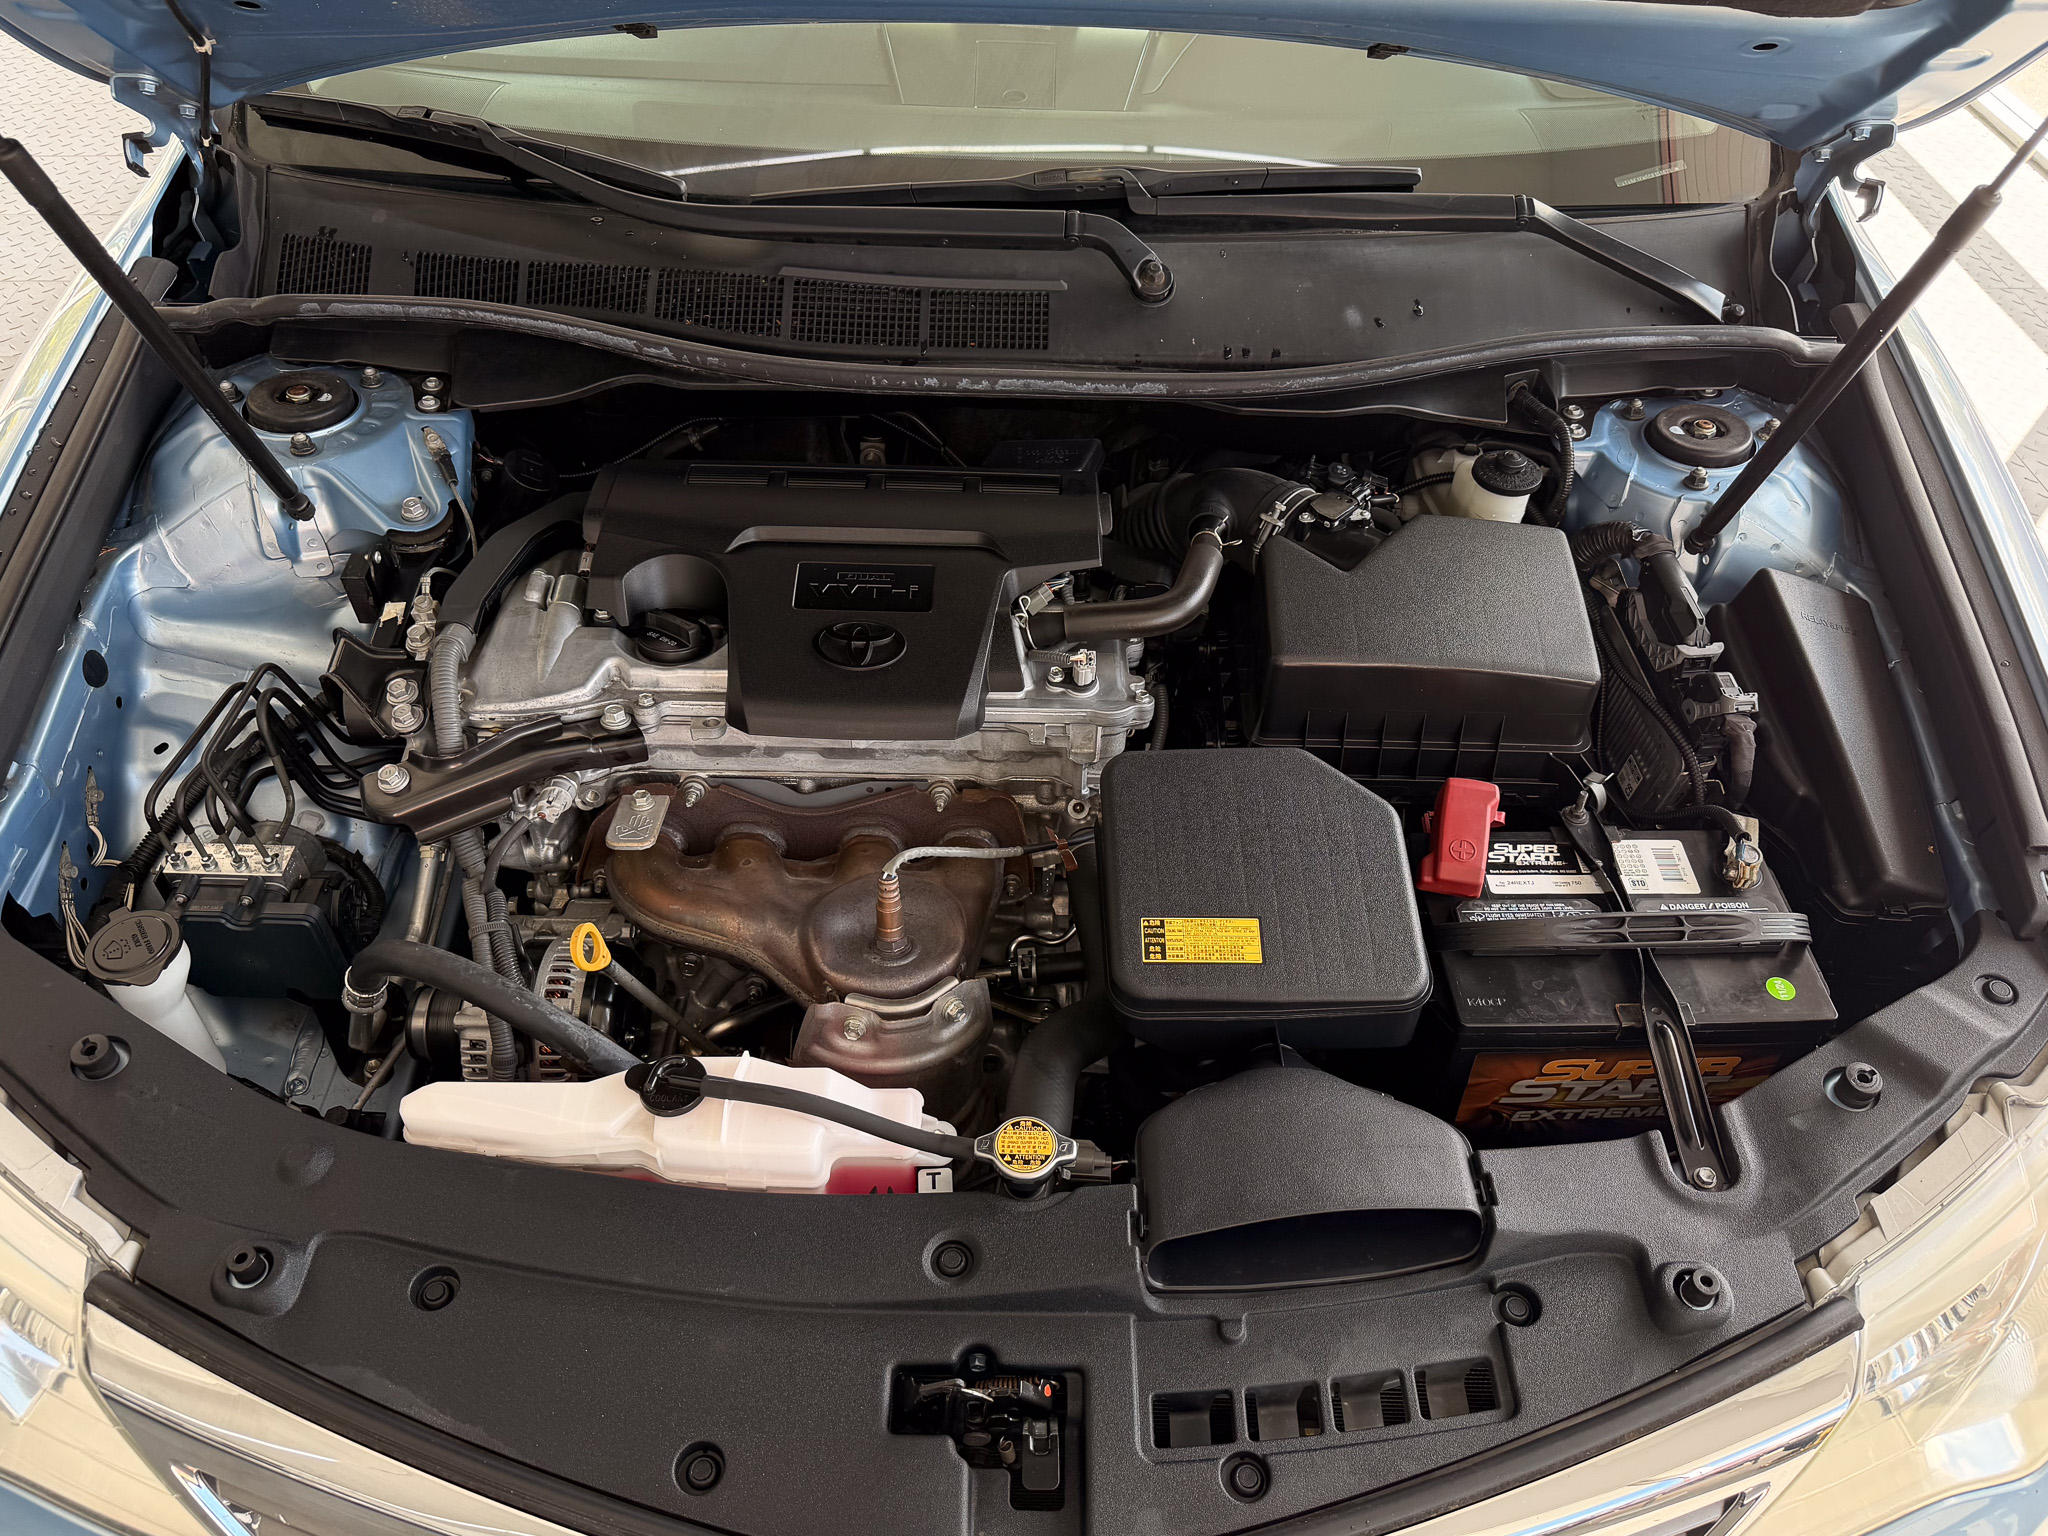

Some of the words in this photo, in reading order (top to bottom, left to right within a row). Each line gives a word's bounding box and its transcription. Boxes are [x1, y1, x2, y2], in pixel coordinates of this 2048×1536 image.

[1493, 843, 1559, 853] SUPER
[1488, 852, 1561, 863] START
[1631, 879, 1646, 887] STD
[1773, 980, 1789, 998] 11/24
[1533, 1056, 1742, 1082] SUPR
[649, 1094, 690, 1103] COOLANT
[926, 1172, 941, 1190] T
